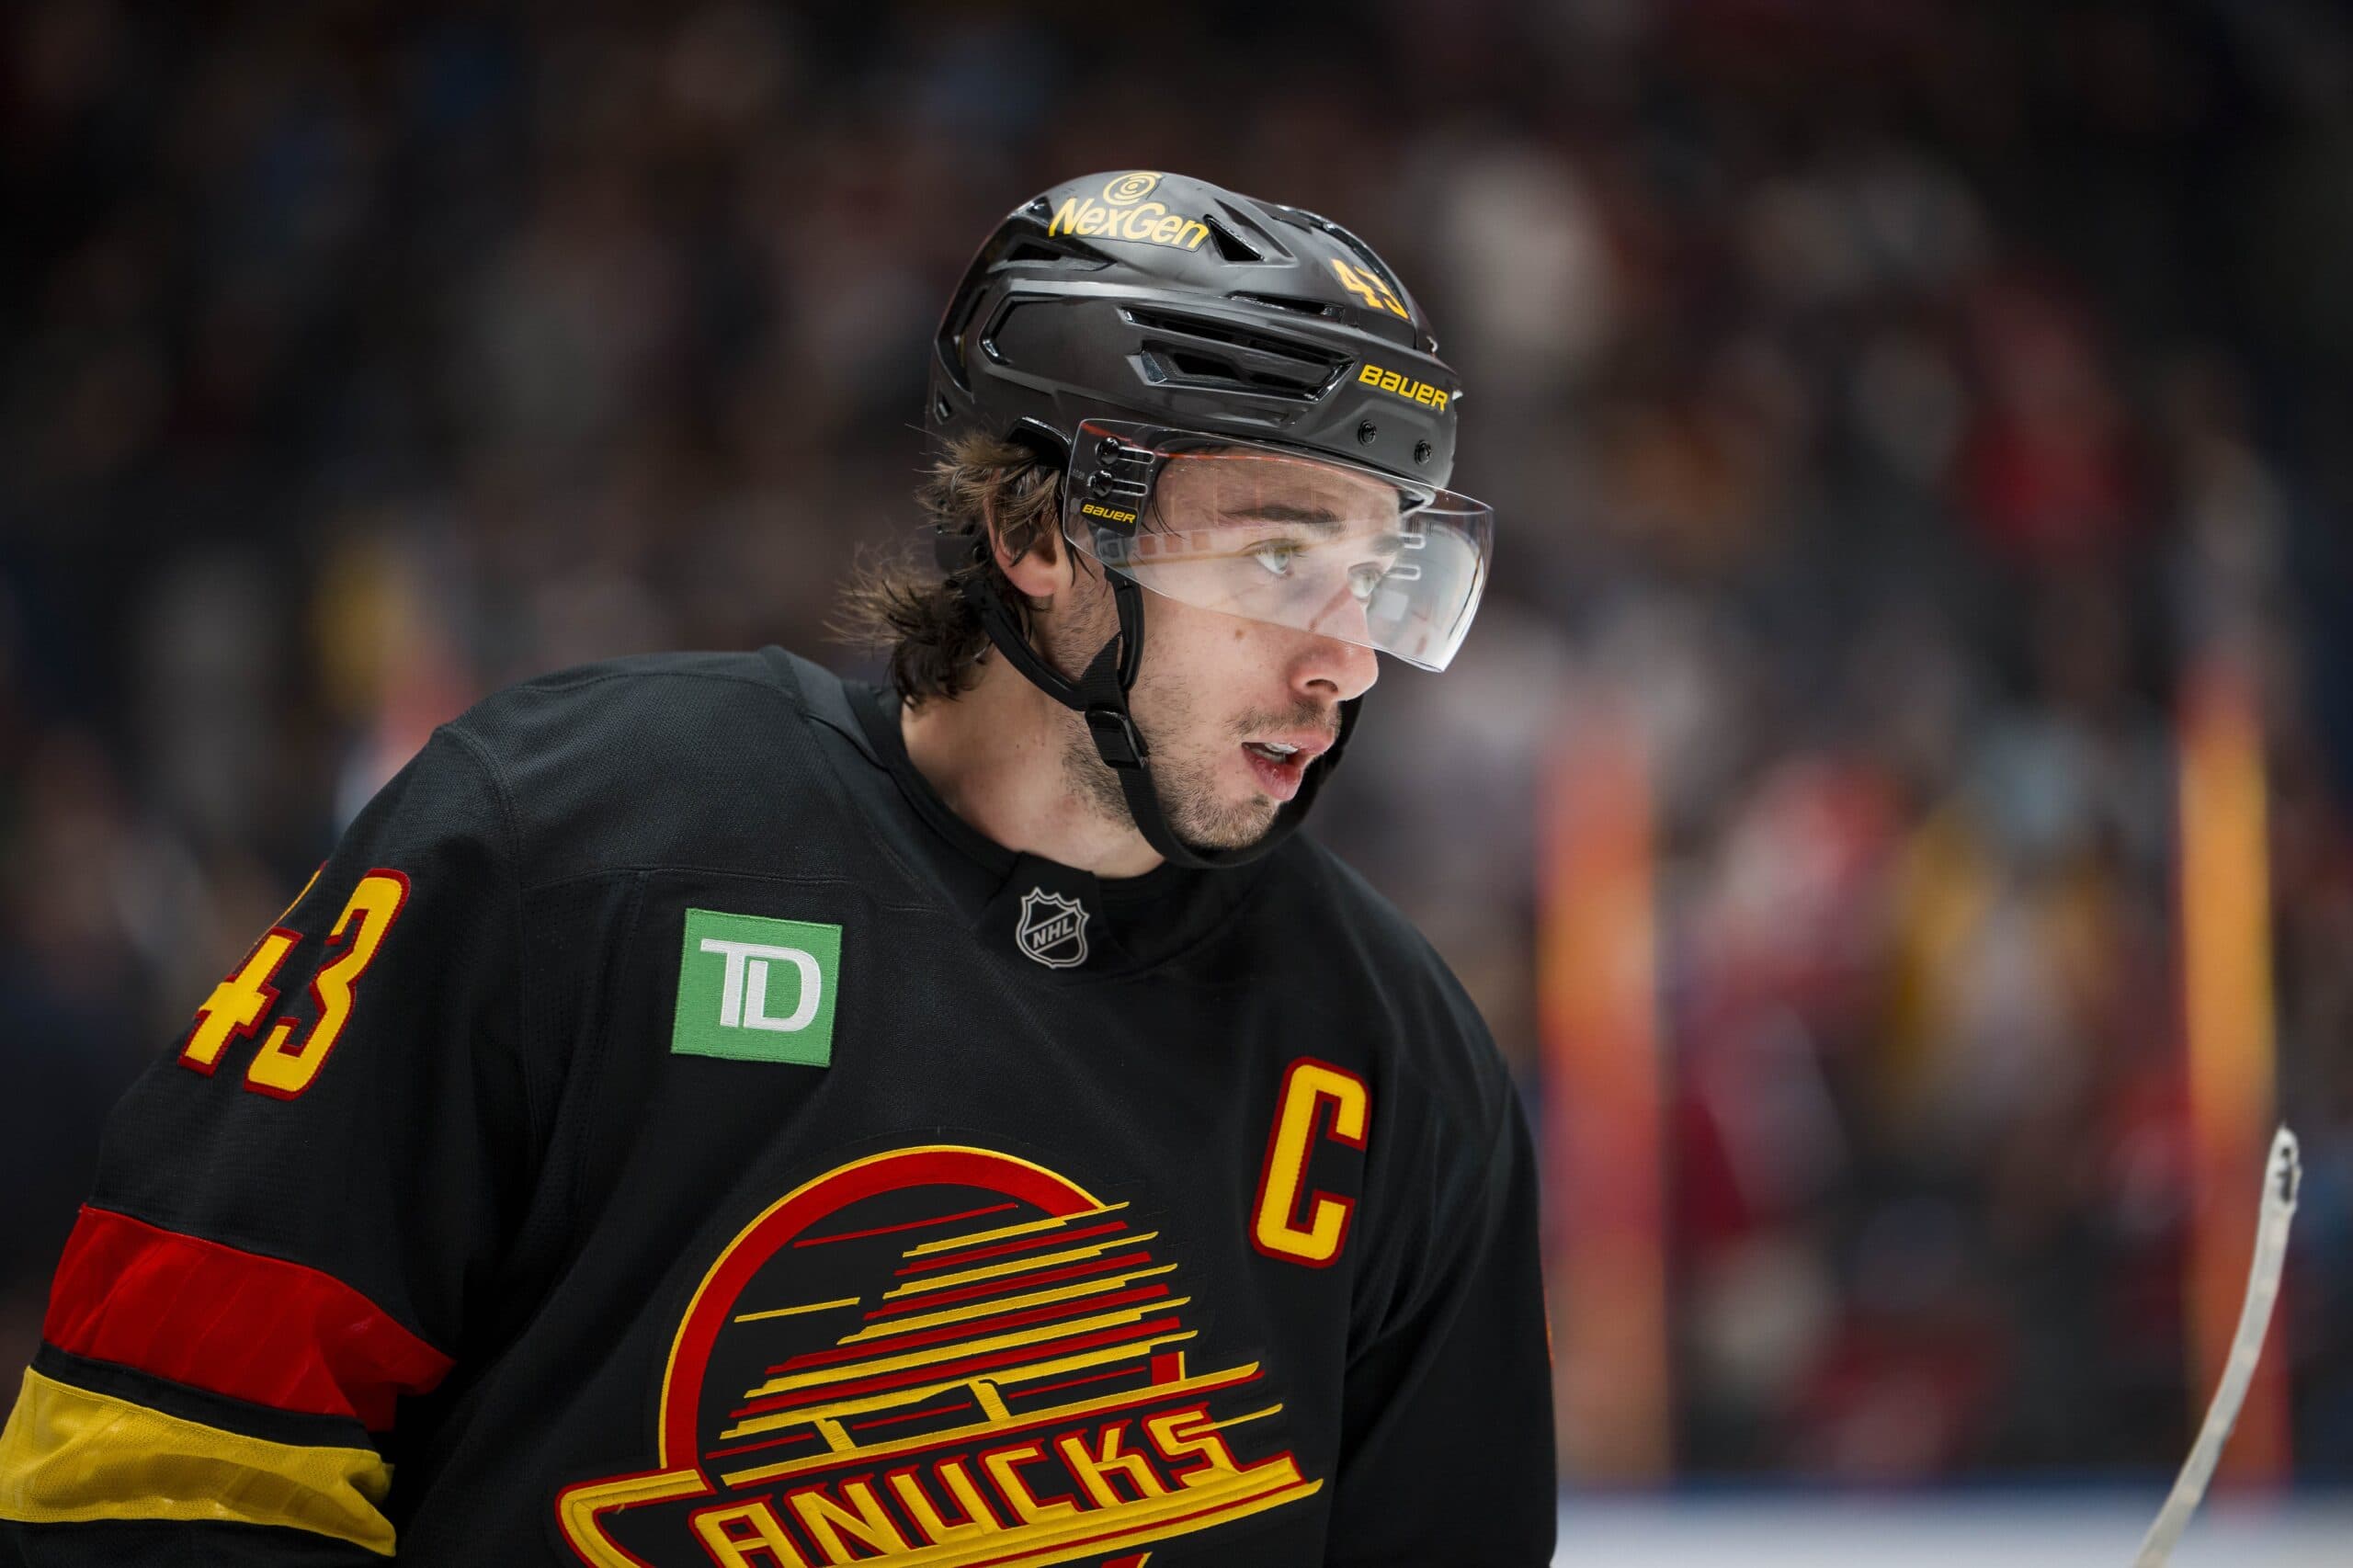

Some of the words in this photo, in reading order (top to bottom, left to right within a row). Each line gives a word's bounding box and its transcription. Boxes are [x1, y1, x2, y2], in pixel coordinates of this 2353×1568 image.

[1048, 198, 1210, 249] NexGen
[1331, 258, 1409, 319] 43
[1033, 917, 1074, 949] NHL
[178, 860, 411, 1101] 43
[699, 937, 822, 1032] TD
[1249, 1056, 1372, 1268] C
